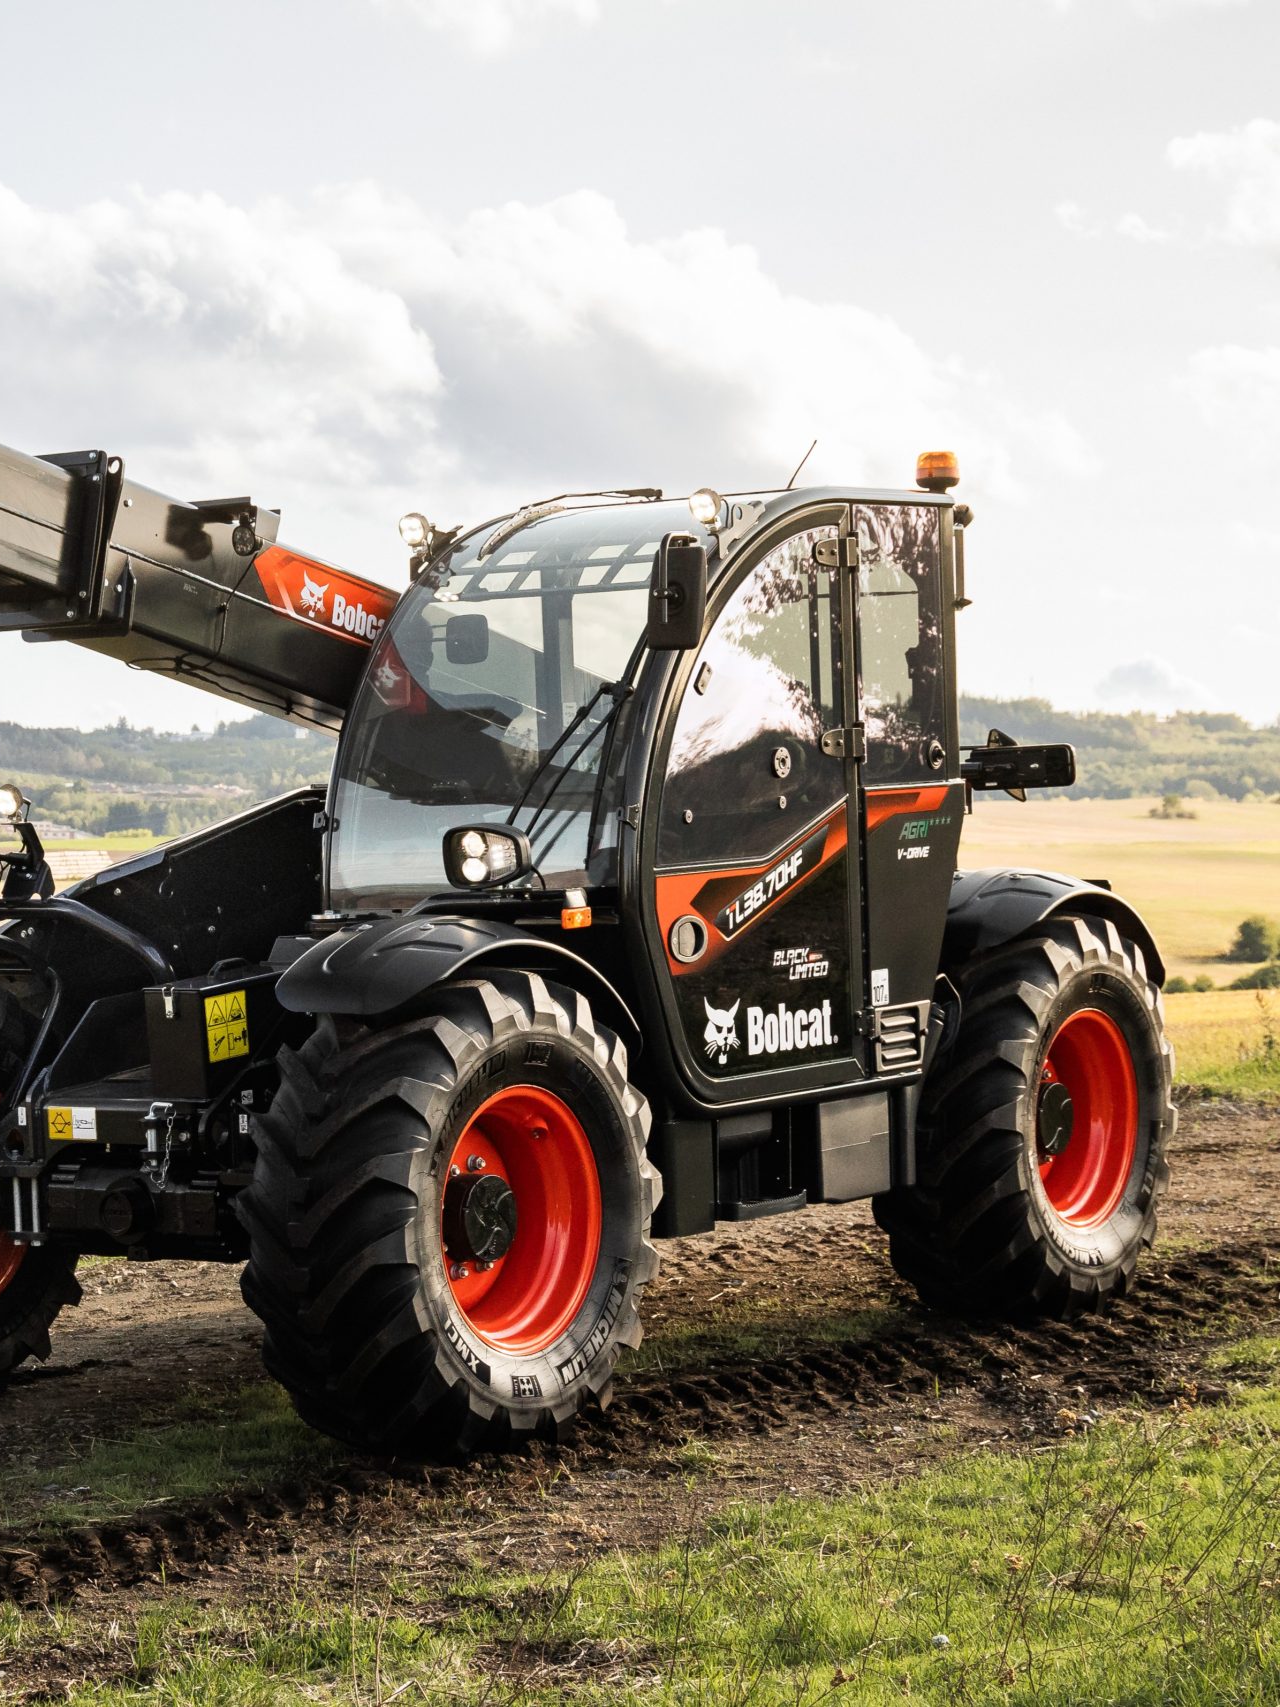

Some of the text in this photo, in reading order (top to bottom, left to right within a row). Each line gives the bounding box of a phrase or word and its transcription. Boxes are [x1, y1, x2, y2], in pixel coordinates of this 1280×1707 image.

[332, 593, 385, 640] Bobca
[898, 820, 929, 840] AGRI
[897, 846, 930, 860] V-DRIVE
[726, 849, 802, 929] TL38.70HF
[773, 948, 809, 966] BLACK
[789, 961, 829, 980] LIMITED
[747, 999, 832, 1056] Bobcat
[561, 1287, 624, 1386] MICHELIN
